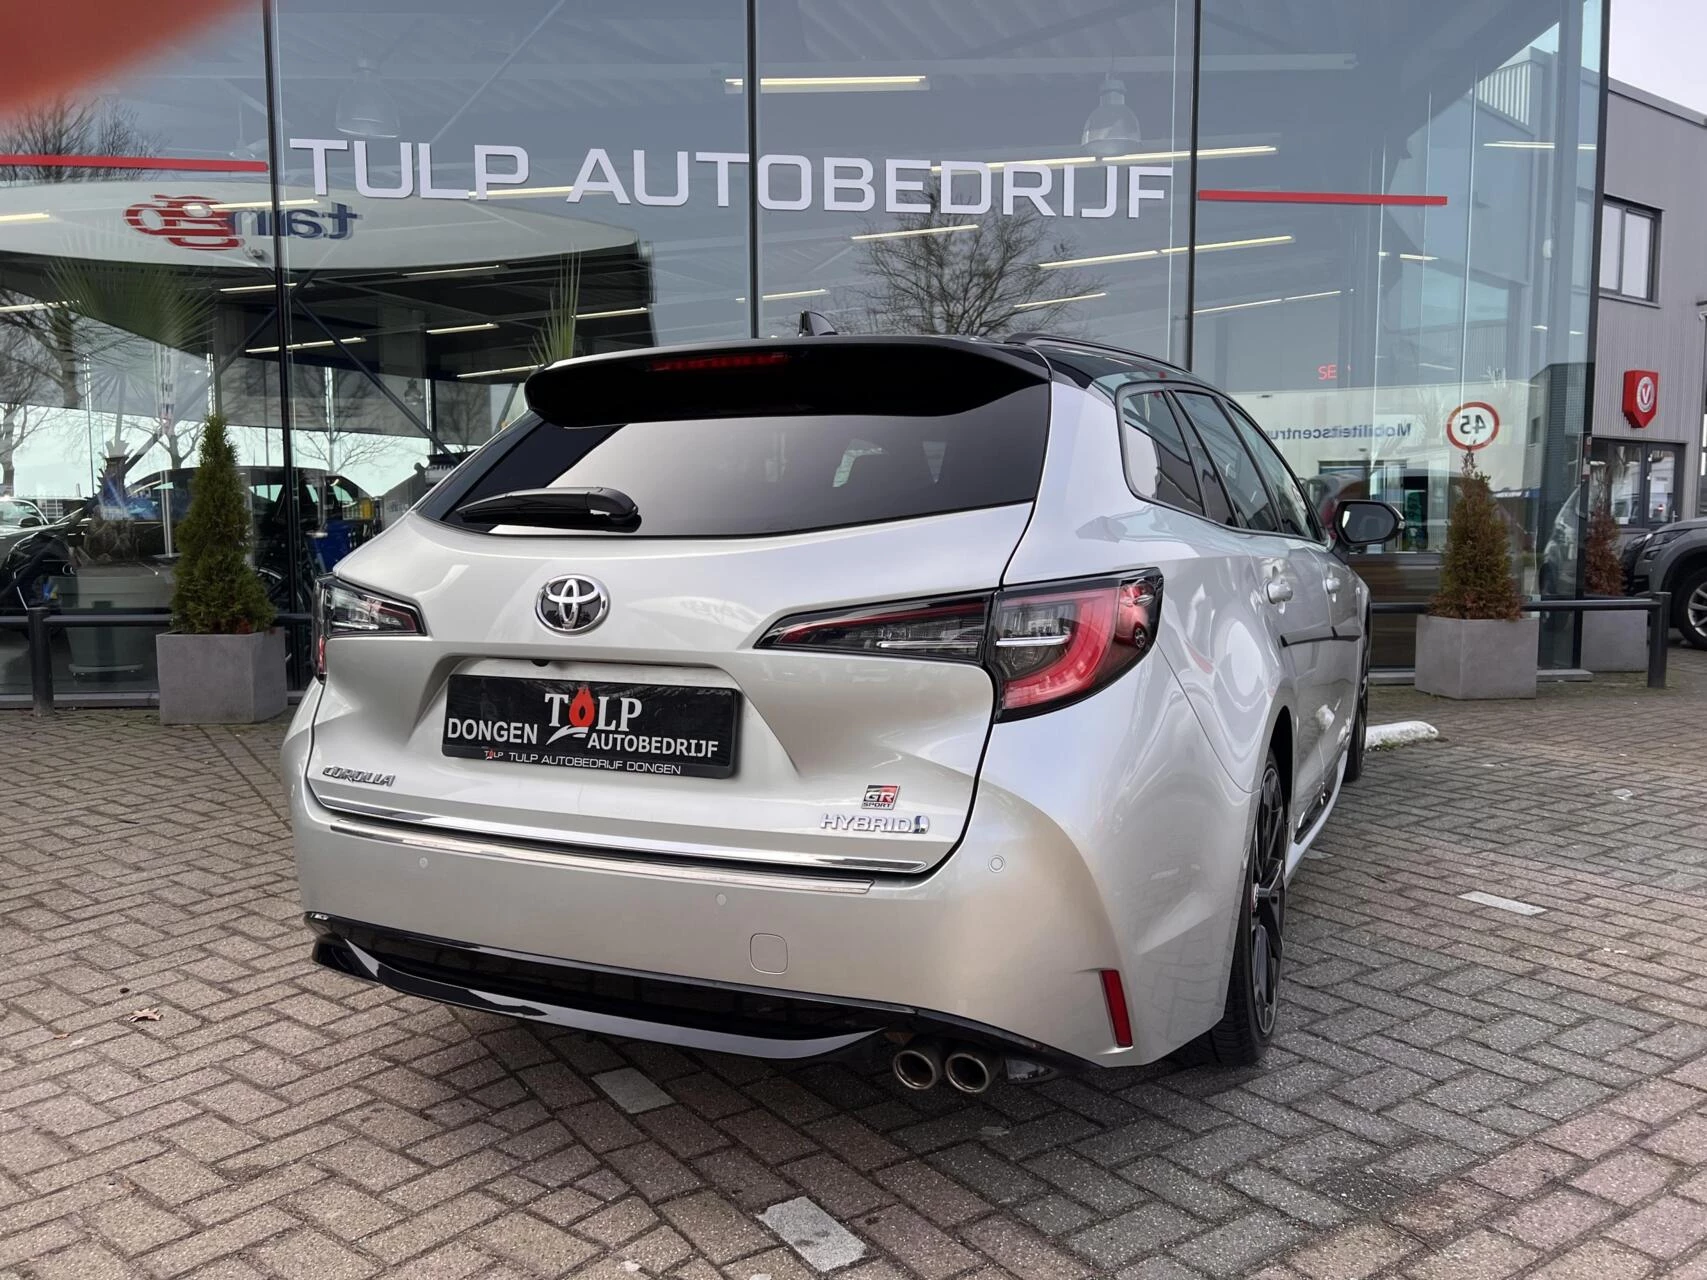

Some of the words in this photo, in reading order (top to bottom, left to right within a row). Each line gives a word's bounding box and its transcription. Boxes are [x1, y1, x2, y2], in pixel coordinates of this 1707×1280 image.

[289, 138, 529, 200] TULP
[566, 148, 1174, 219] AUTOBEDRIJF
[447, 717, 538, 744] DONGEN
[587, 731, 719, 758] AUTOBEDRIJF
[509, 752, 539, 764] TULP
[541, 755, 623, 770] AUTOBEDRIJF
[626, 761, 682, 775] DONGEN
[322, 766, 396, 787] COROLLA
[862, 801, 892, 809] SPORT
[864, 791, 895, 803] GR
[820, 813, 913, 833] HYBRID
